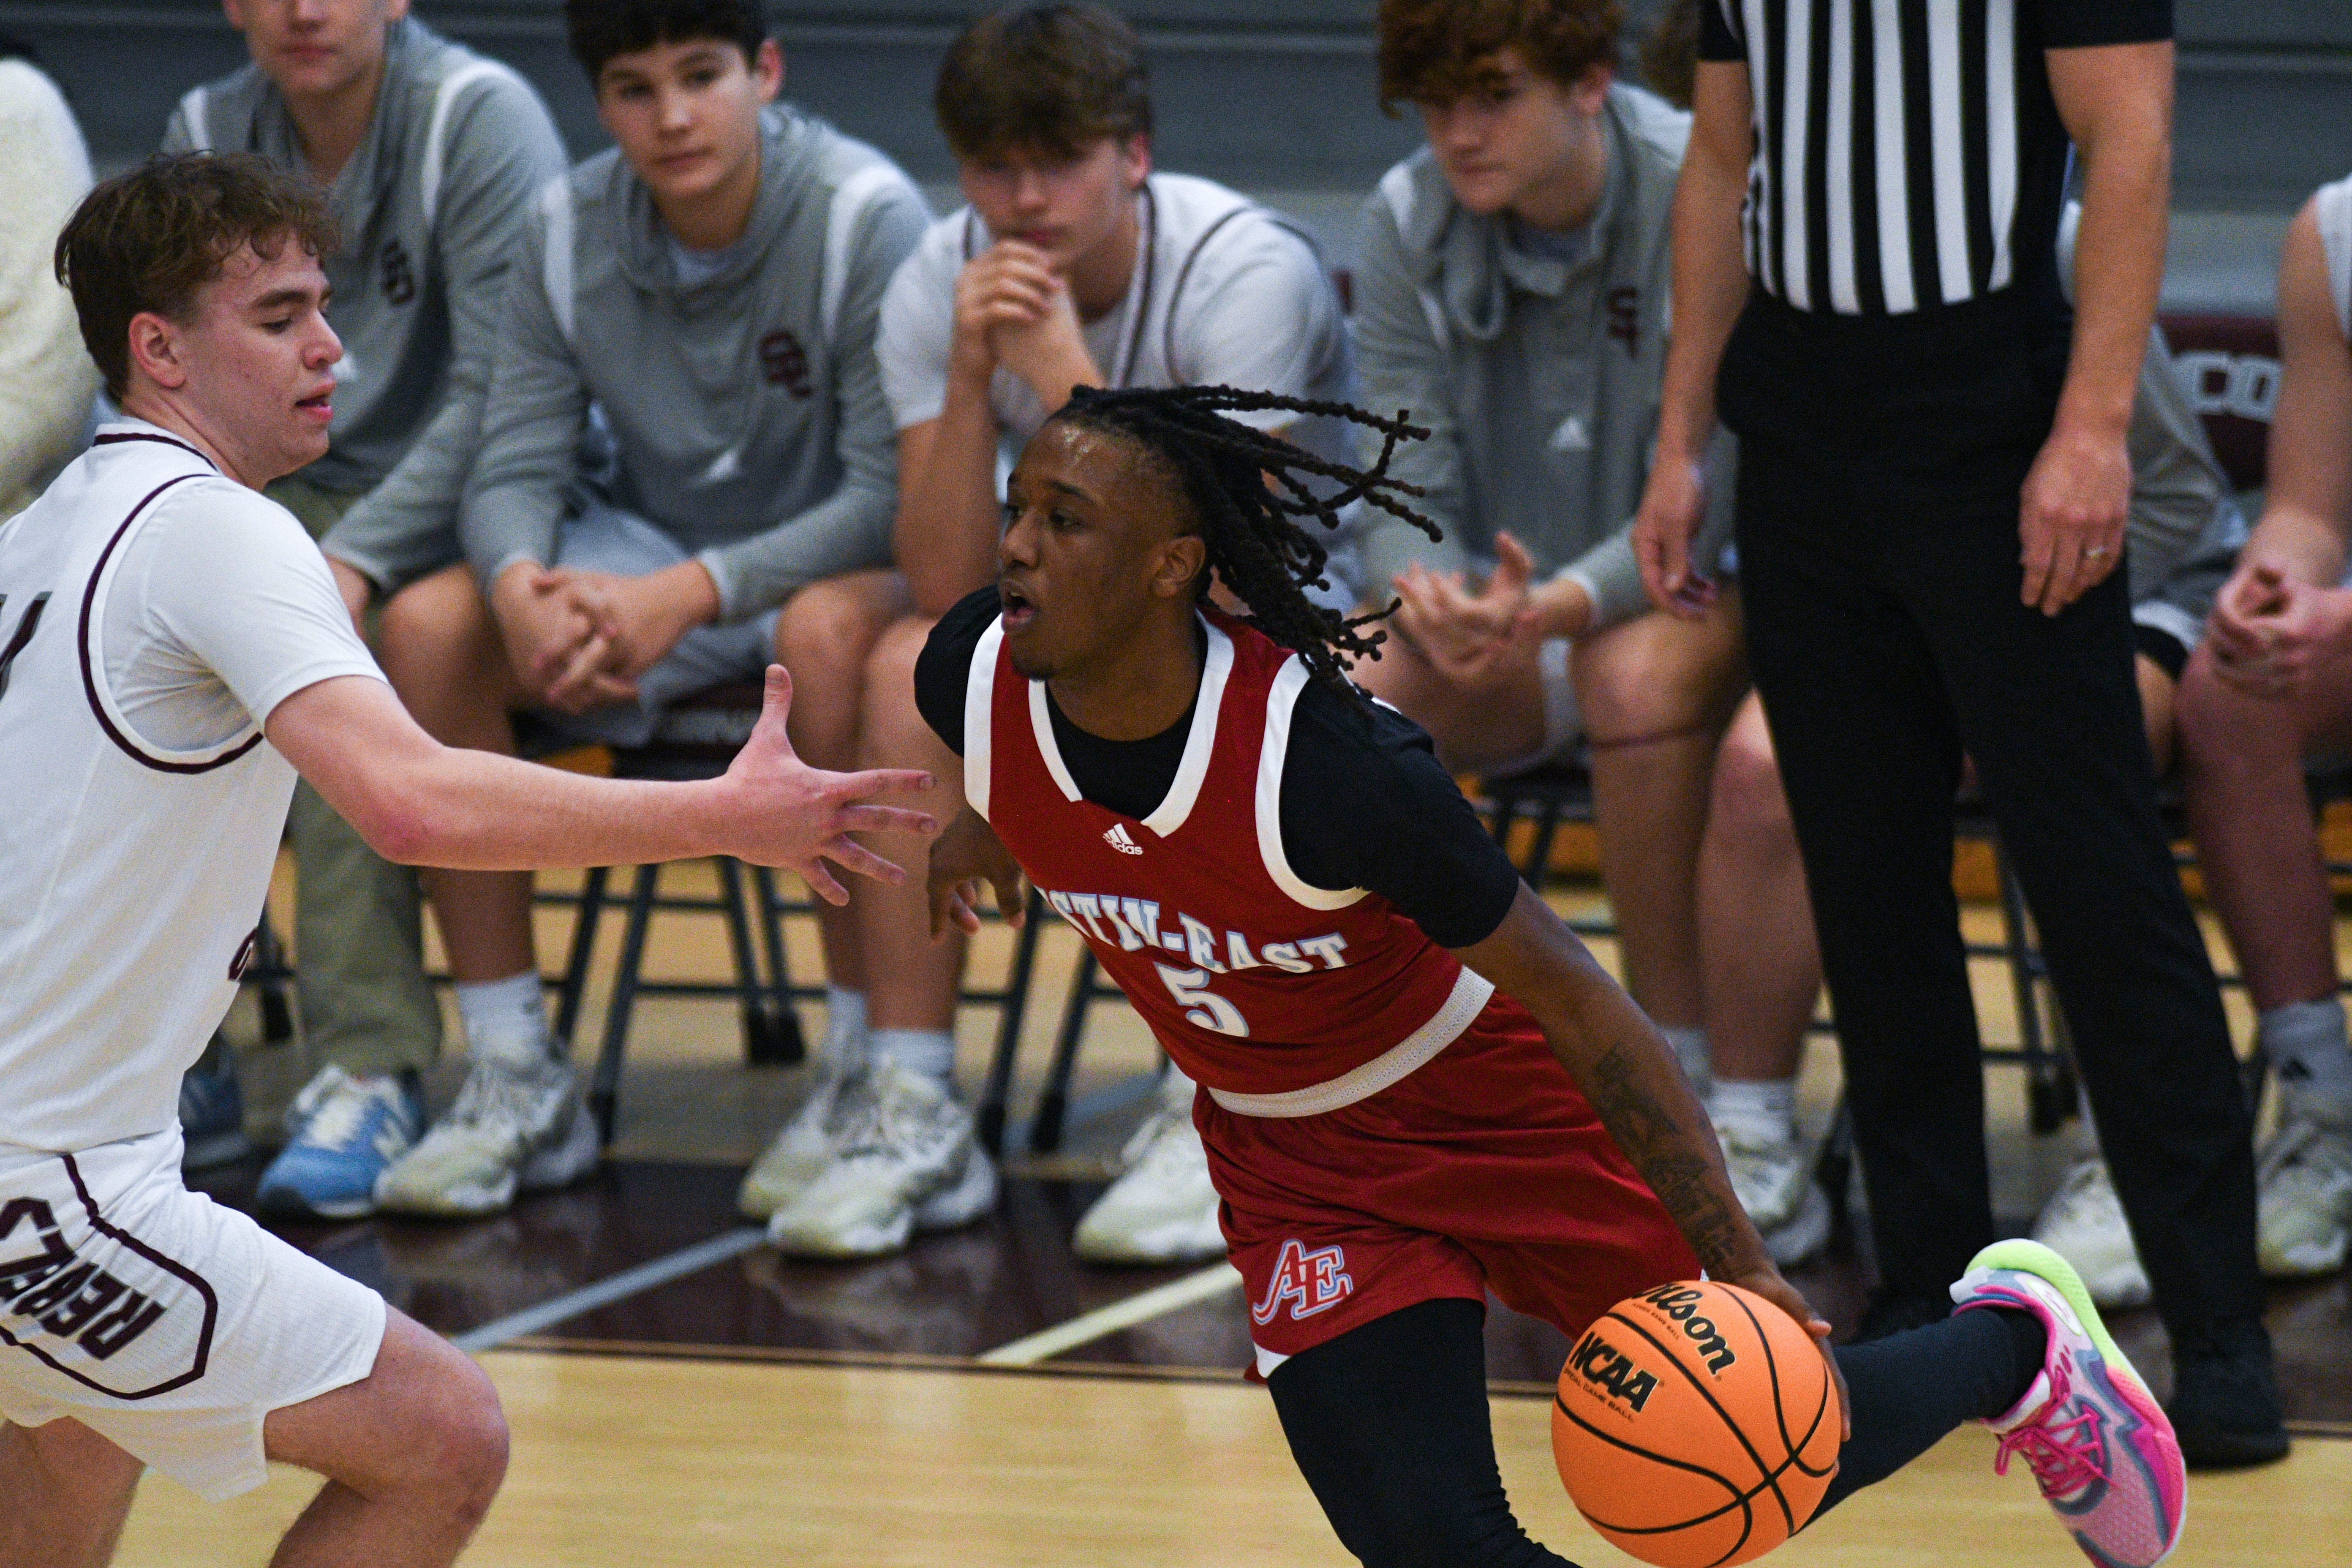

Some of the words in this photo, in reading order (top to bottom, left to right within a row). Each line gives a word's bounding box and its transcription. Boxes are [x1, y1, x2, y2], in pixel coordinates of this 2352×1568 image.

[1034, 885, 1352, 974] STIN-EAST
[1156, 962, 1249, 1037] 5
[1253, 1239, 1353, 1325] AE
[1631, 1282, 1736, 1376] ilson
[1568, 1331, 1660, 1413] NCAA
[1608, 1400, 1634, 1423] BALL
